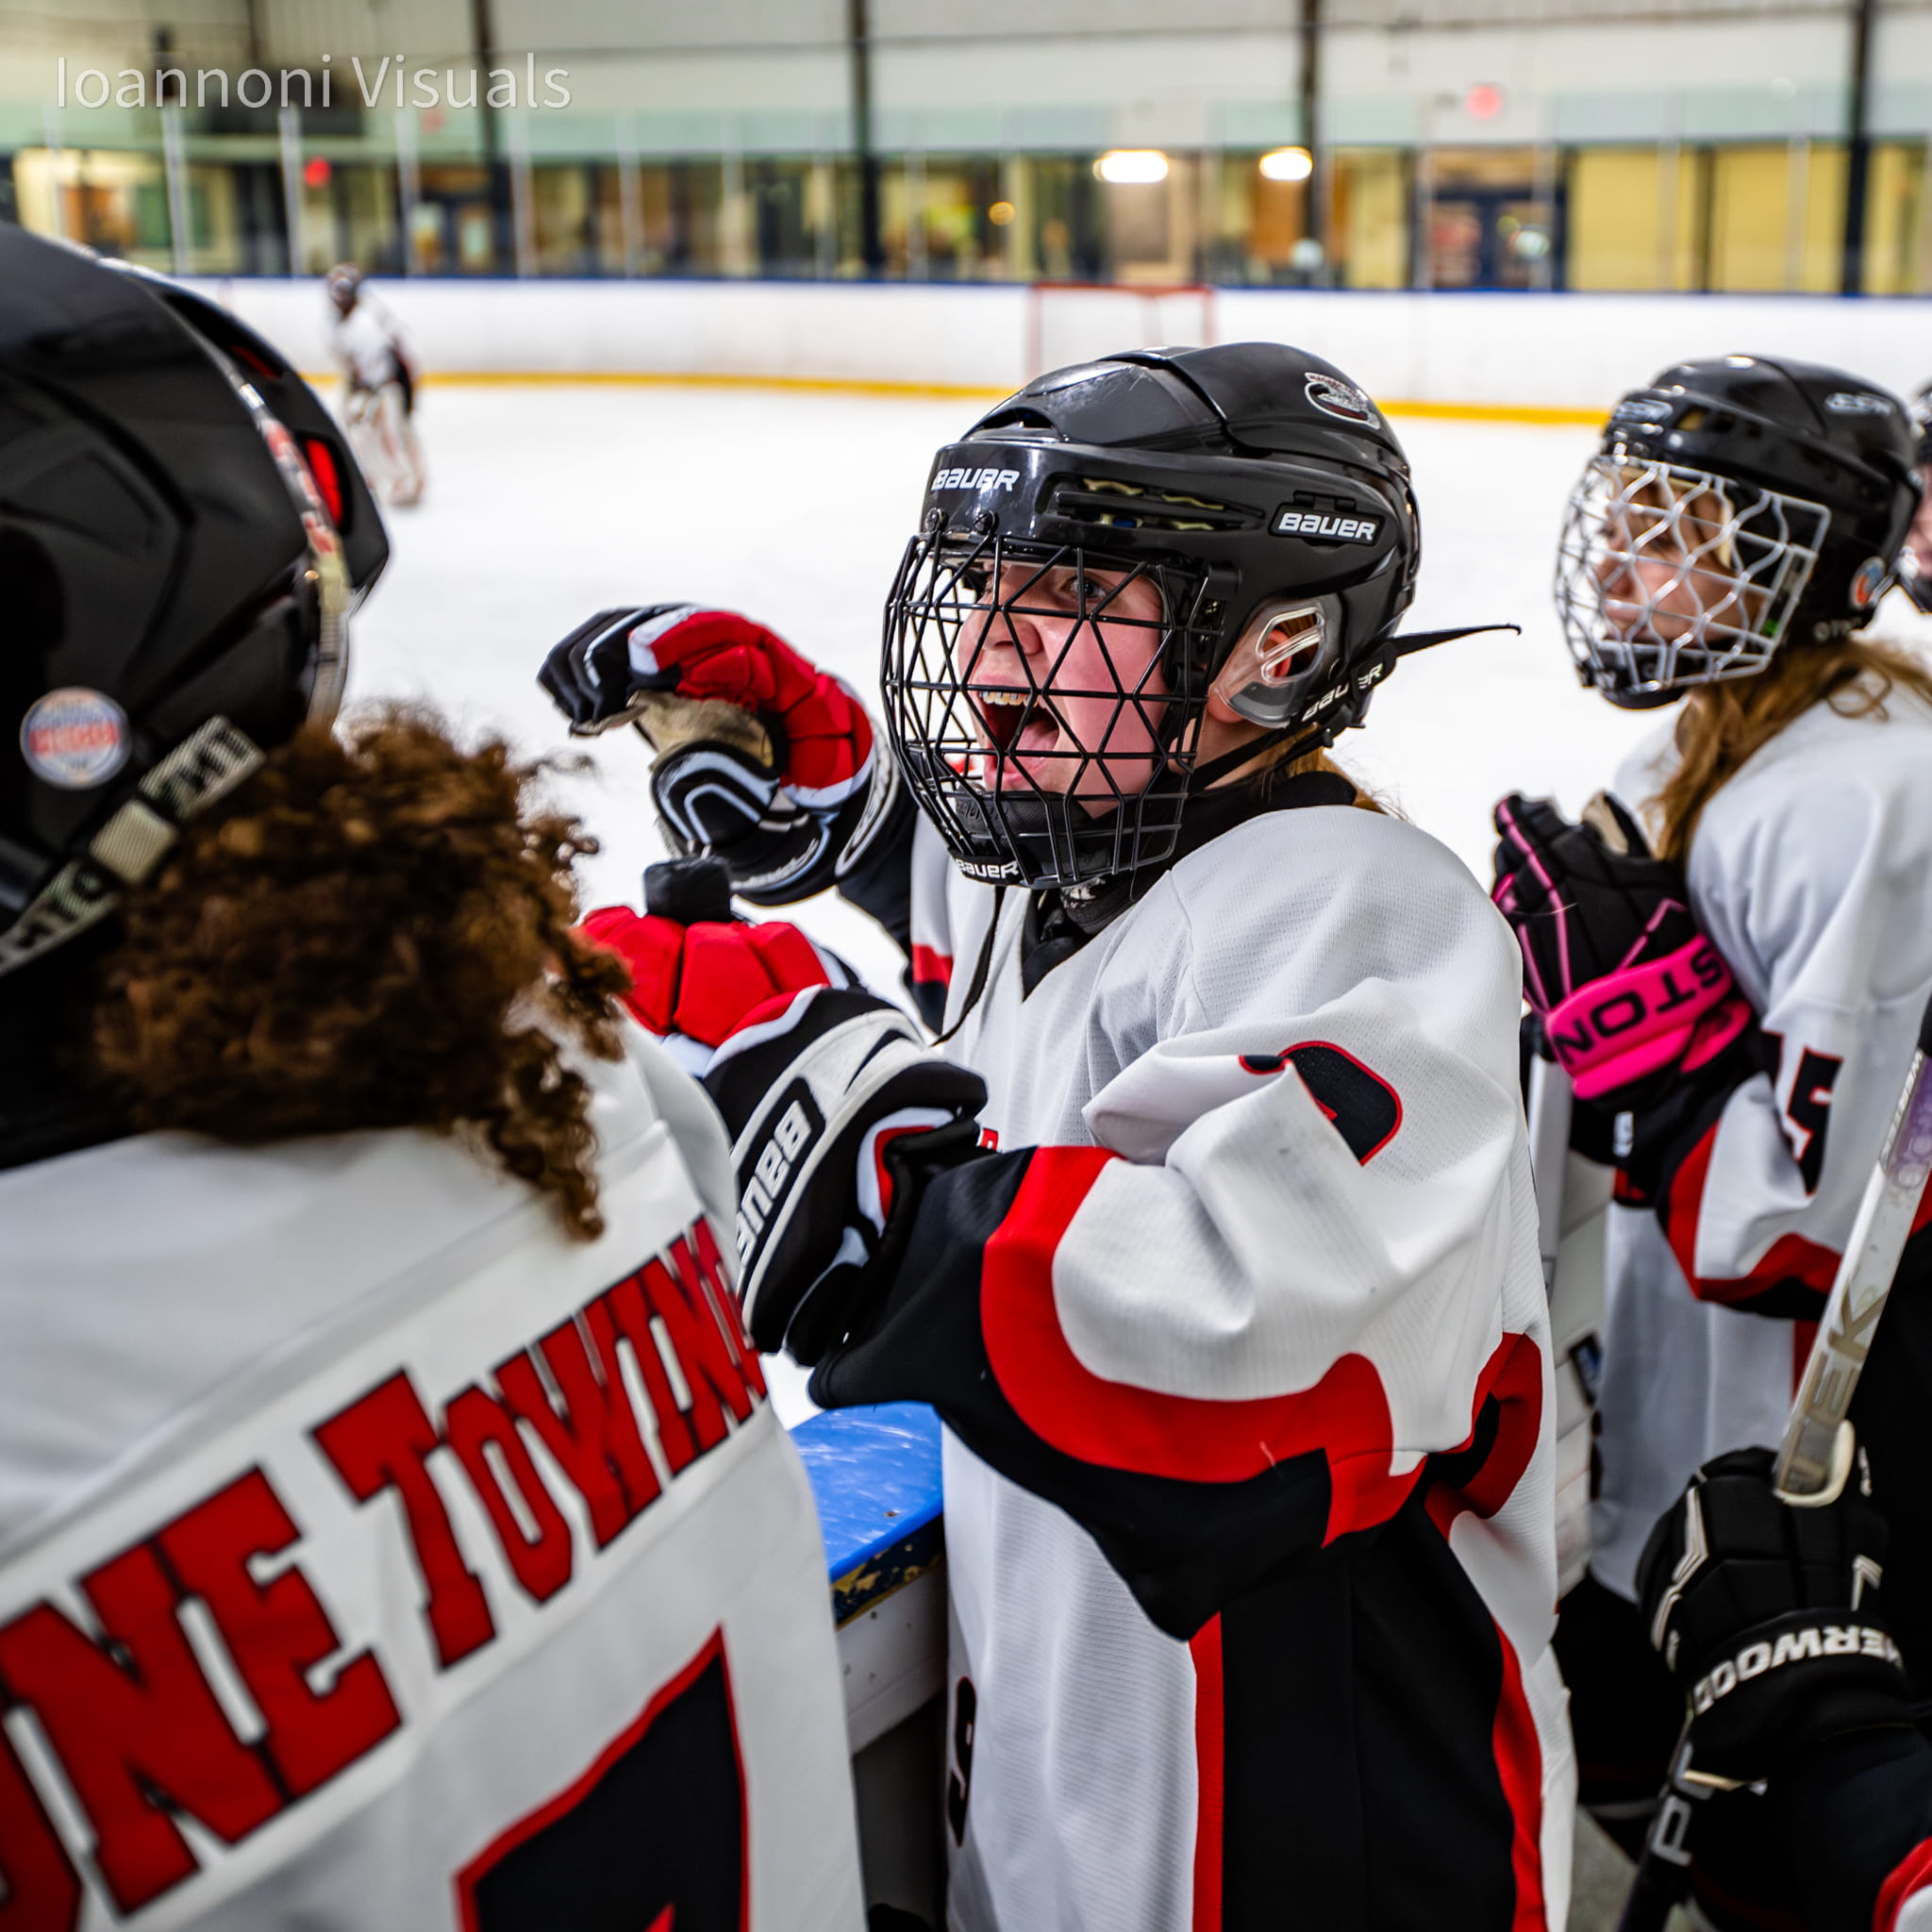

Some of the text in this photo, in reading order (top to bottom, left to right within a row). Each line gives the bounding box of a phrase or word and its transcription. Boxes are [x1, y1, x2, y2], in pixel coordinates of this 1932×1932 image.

[931, 468, 1021, 492] BAUER
[1278, 512, 1376, 541] BAUER
[736, 1100, 813, 1266] BAUE
